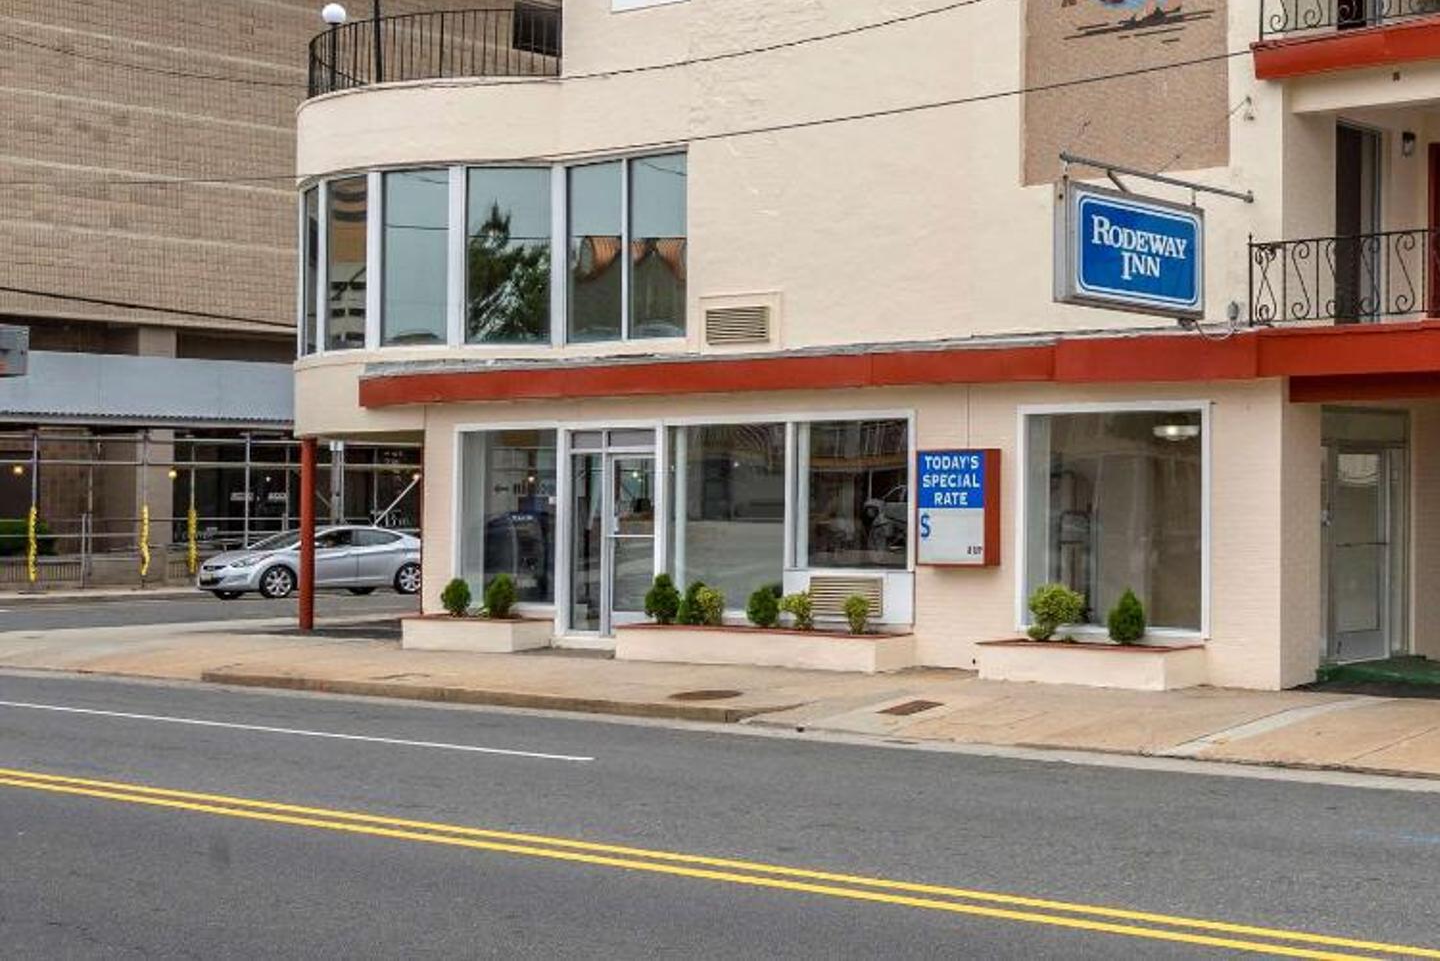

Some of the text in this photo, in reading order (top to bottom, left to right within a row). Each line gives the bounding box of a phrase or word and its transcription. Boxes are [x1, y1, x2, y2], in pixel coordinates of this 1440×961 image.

[1092, 214, 1187, 259] RODEWAY
[1121, 251, 1161, 280] INN
[924, 455, 980, 471] TODAY'S
[922, 473, 981, 489] SPECIAL
[933, 491, 969, 506] RATE
